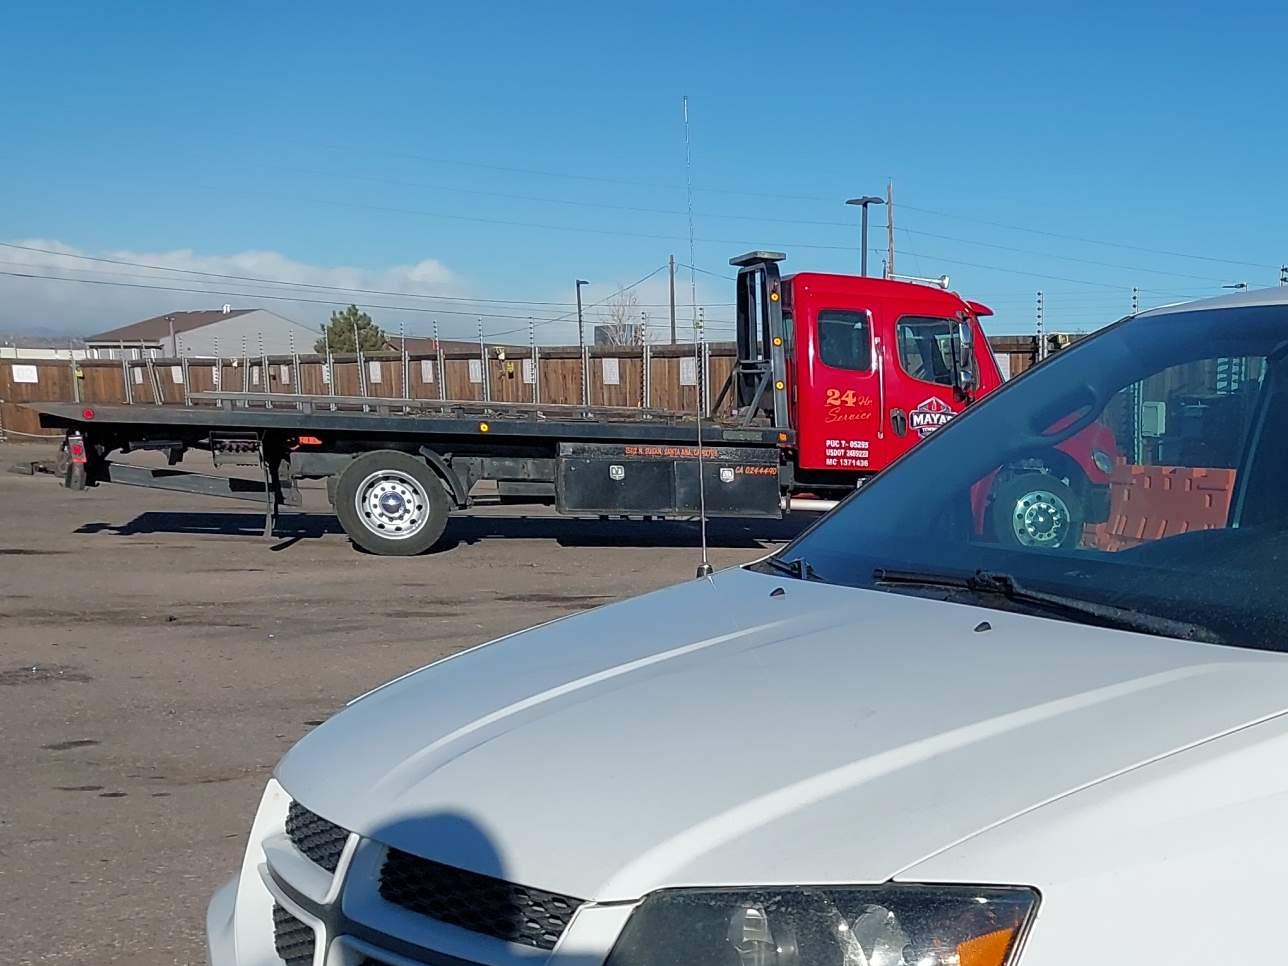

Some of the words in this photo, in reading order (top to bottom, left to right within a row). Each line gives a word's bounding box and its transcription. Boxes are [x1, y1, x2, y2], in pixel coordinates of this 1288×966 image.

[826, 388, 857, 407] 24
[824, 406, 872, 424] Service
[825, 439, 840, 448] PUC
[825, 448, 845, 457] USDOT
[825, 458, 838, 466] MC
